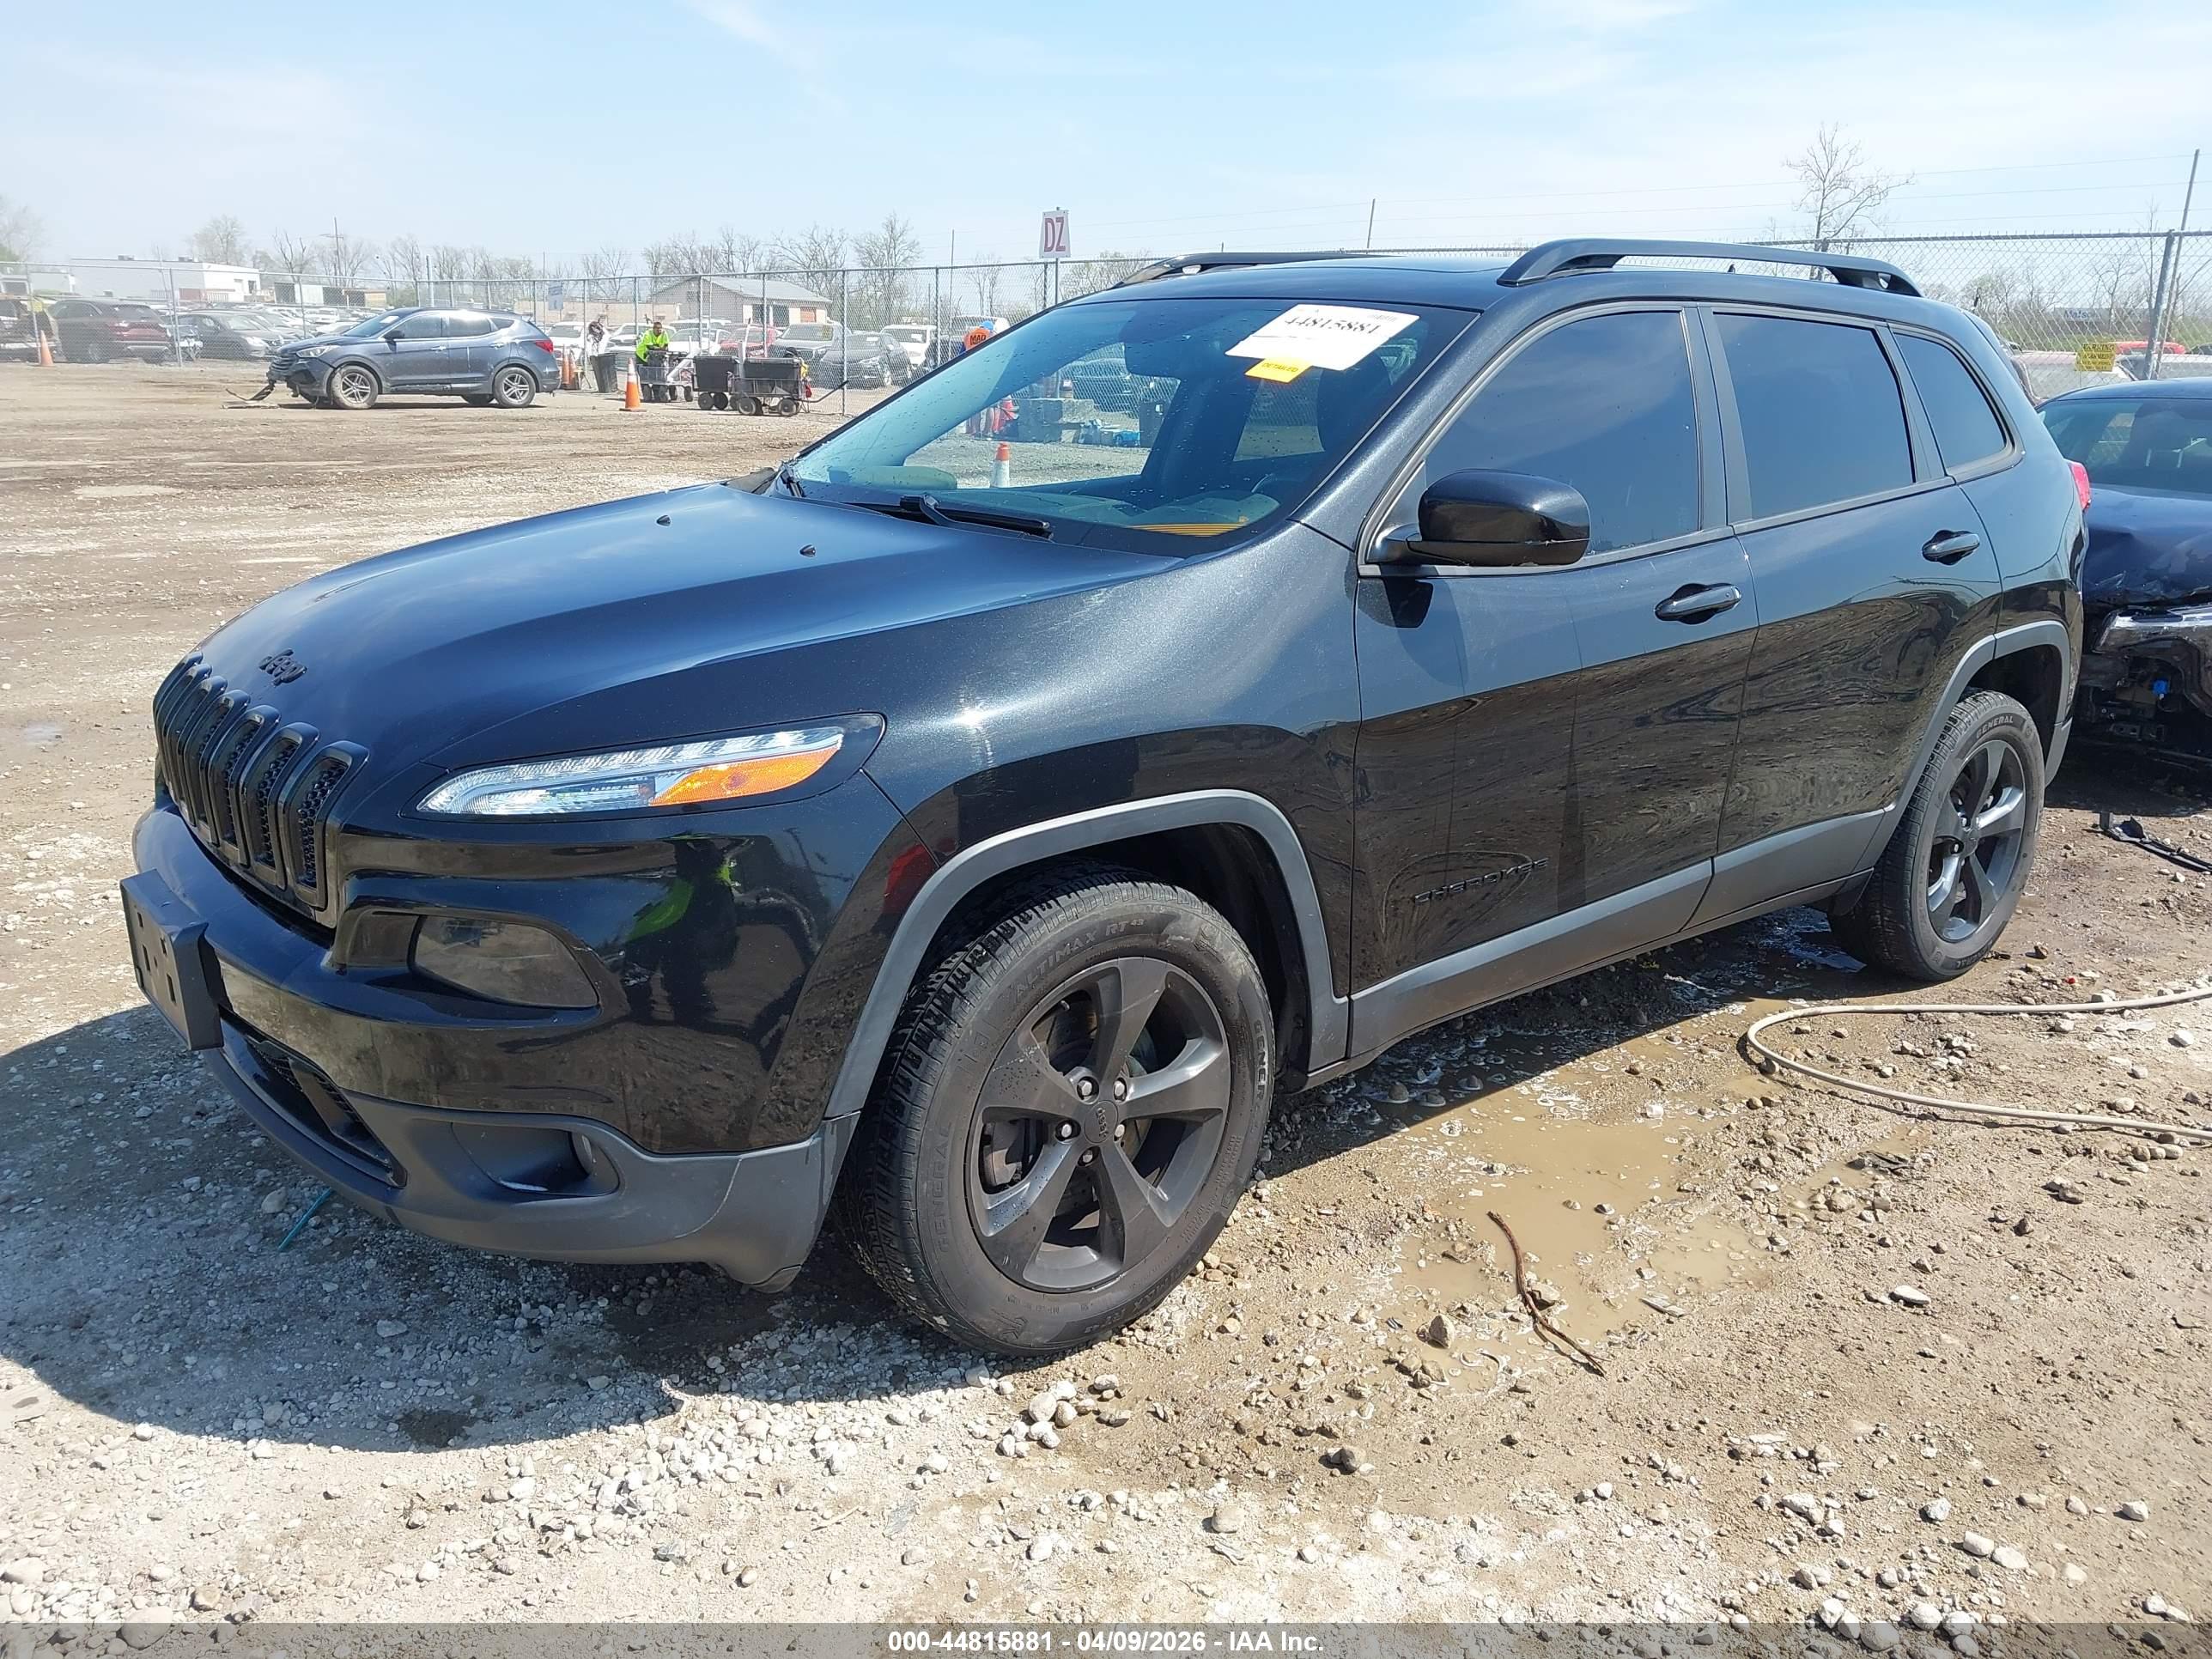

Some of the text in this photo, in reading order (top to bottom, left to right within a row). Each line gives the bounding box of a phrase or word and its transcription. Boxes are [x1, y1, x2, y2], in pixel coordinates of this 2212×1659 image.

[1044, 216, 1066, 252] DZ
[1285, 316, 1382, 334] 44815881
[1977, 715, 2014, 738] GENERAL
[1415, 858, 1549, 904] CHEROKEE
[1015, 930, 1097, 1000] ALTIMAX
